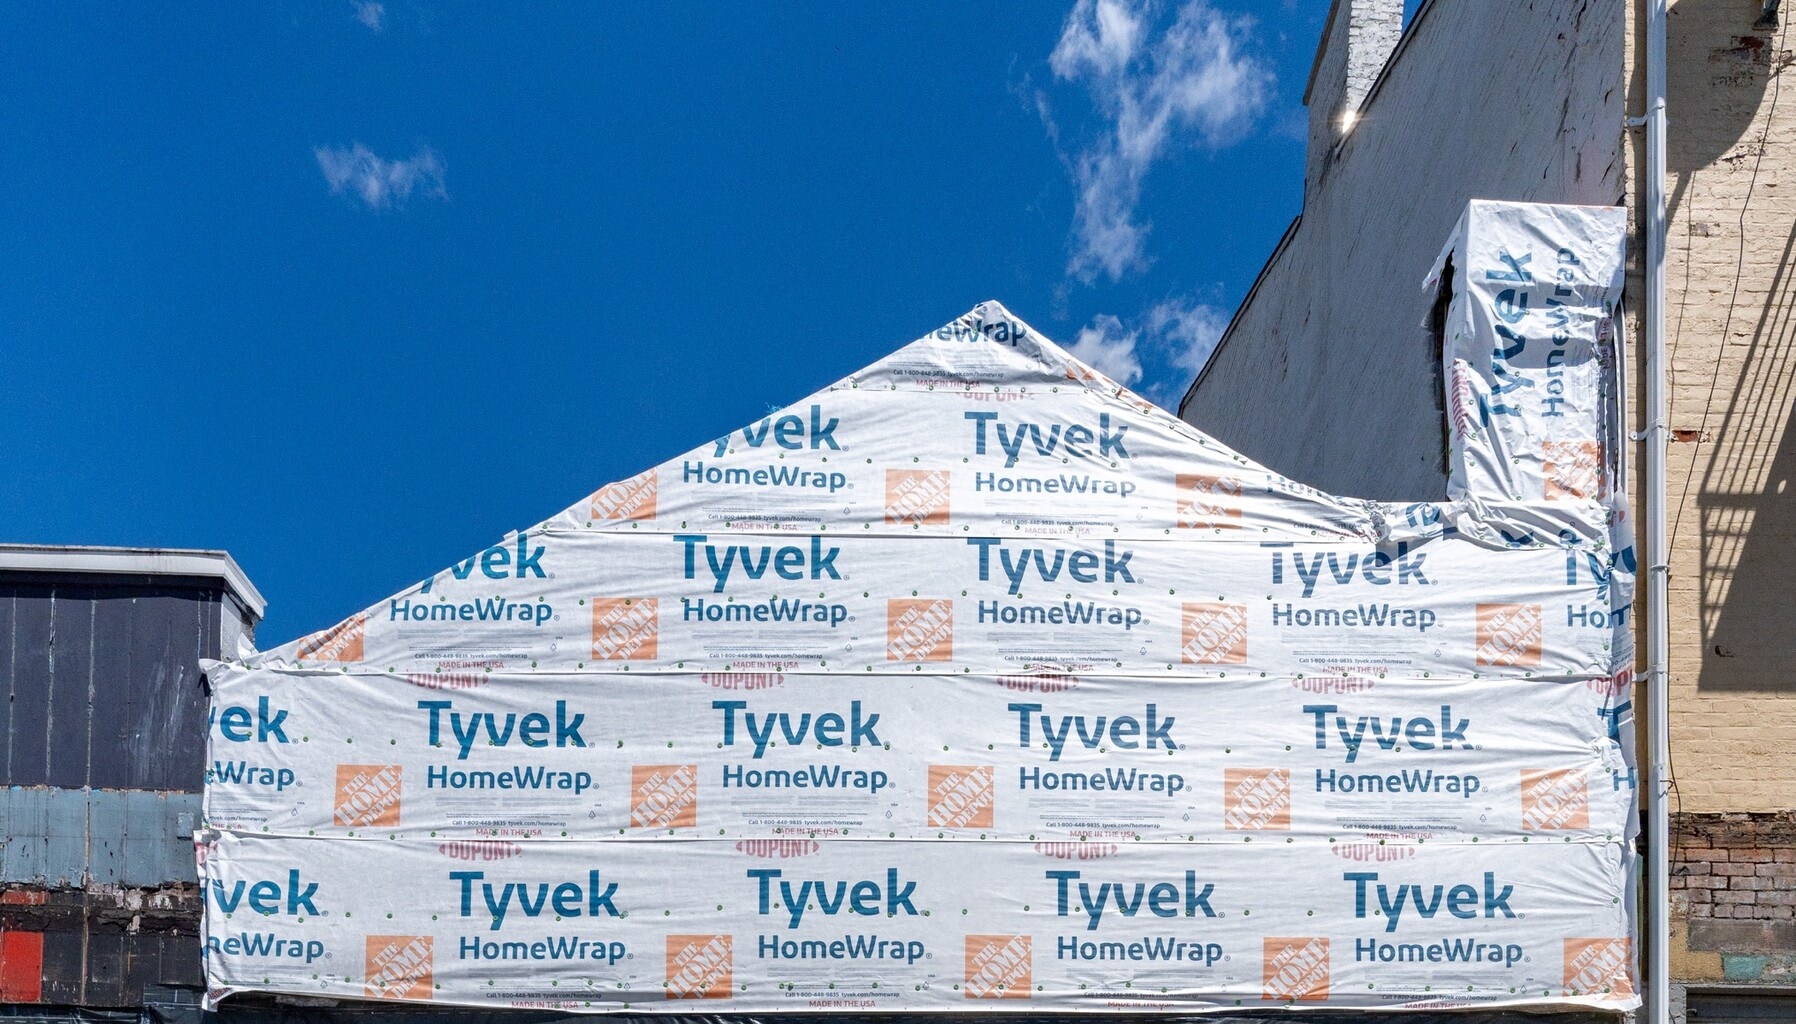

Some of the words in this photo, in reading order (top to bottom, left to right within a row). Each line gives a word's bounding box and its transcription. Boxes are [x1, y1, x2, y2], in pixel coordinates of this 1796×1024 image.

[928, 320, 1025, 347] eWrap
[1480, 252, 1535, 427] Tyvek
[1540, 247, 1580, 418] HomeWrap
[964, 412, 1130, 468] Tyvek
[684, 461, 846, 492] HomeWrap
[976, 472, 1136, 498] HomeWrap
[673, 535, 842, 592] Tyvek
[967, 538, 1136, 595] Tyvek
[1260, 541, 1430, 598] Tyvek
[390, 599, 552, 626] HomeWrap
[593, 599, 658, 659] HOME
[600, 605, 626, 629] THE
[684, 599, 847, 627] HomeWrap
[978, 600, 1141, 630] HomeWrap
[1273, 604, 1436, 632] HomeWrap
[620, 624, 658, 660] DEPOT
[710, 652, 721, 660] Call
[733, 661, 755, 669] MADE
[757, 661, 765, 669] IN
[767, 661, 782, 669] THE
[785, 661, 798, 669] USA
[418, 700, 587, 760] Tyvek
[712, 701, 882, 759] Tyvek
[1008, 704, 1178, 762] Tyvek
[1303, 705, 1473, 763] Tyvek
[334, 766, 402, 826] HOME
[341, 772, 368, 796] THE
[428, 766, 592, 794] HomeWrap
[723, 765, 887, 794] HomeWrap
[934, 773, 960, 796] THE
[1020, 767, 1184, 796] HomeWrap
[1316, 769, 1480, 798] HomeWrap
[362, 791, 402, 827] DEPOT
[928, 767, 993, 826] HOME
[955, 792, 993, 827] DEPOT
[450, 870, 620, 930] Tyvek
[747, 868, 918, 929] Tyvek
[1046, 870, 1216, 930] Tyvek
[1344, 872, 1518, 932] Tyvek
[460, 936, 625, 965] HomeWrap
[673, 942, 699, 967] THE
[759, 935, 924, 964] HomeWrap
[1058, 936, 1222, 966] HomeWrap
[1356, 938, 1522, 968] HomeWrap
[666, 936, 732, 998] HOME
[693, 962, 732, 999] DEPOT
[809, 1000, 832, 1008] MADE
[834, 1000, 842, 1008] IN
[844, 1000, 859, 1008] THE
[862, 1000, 876, 1008] USA
